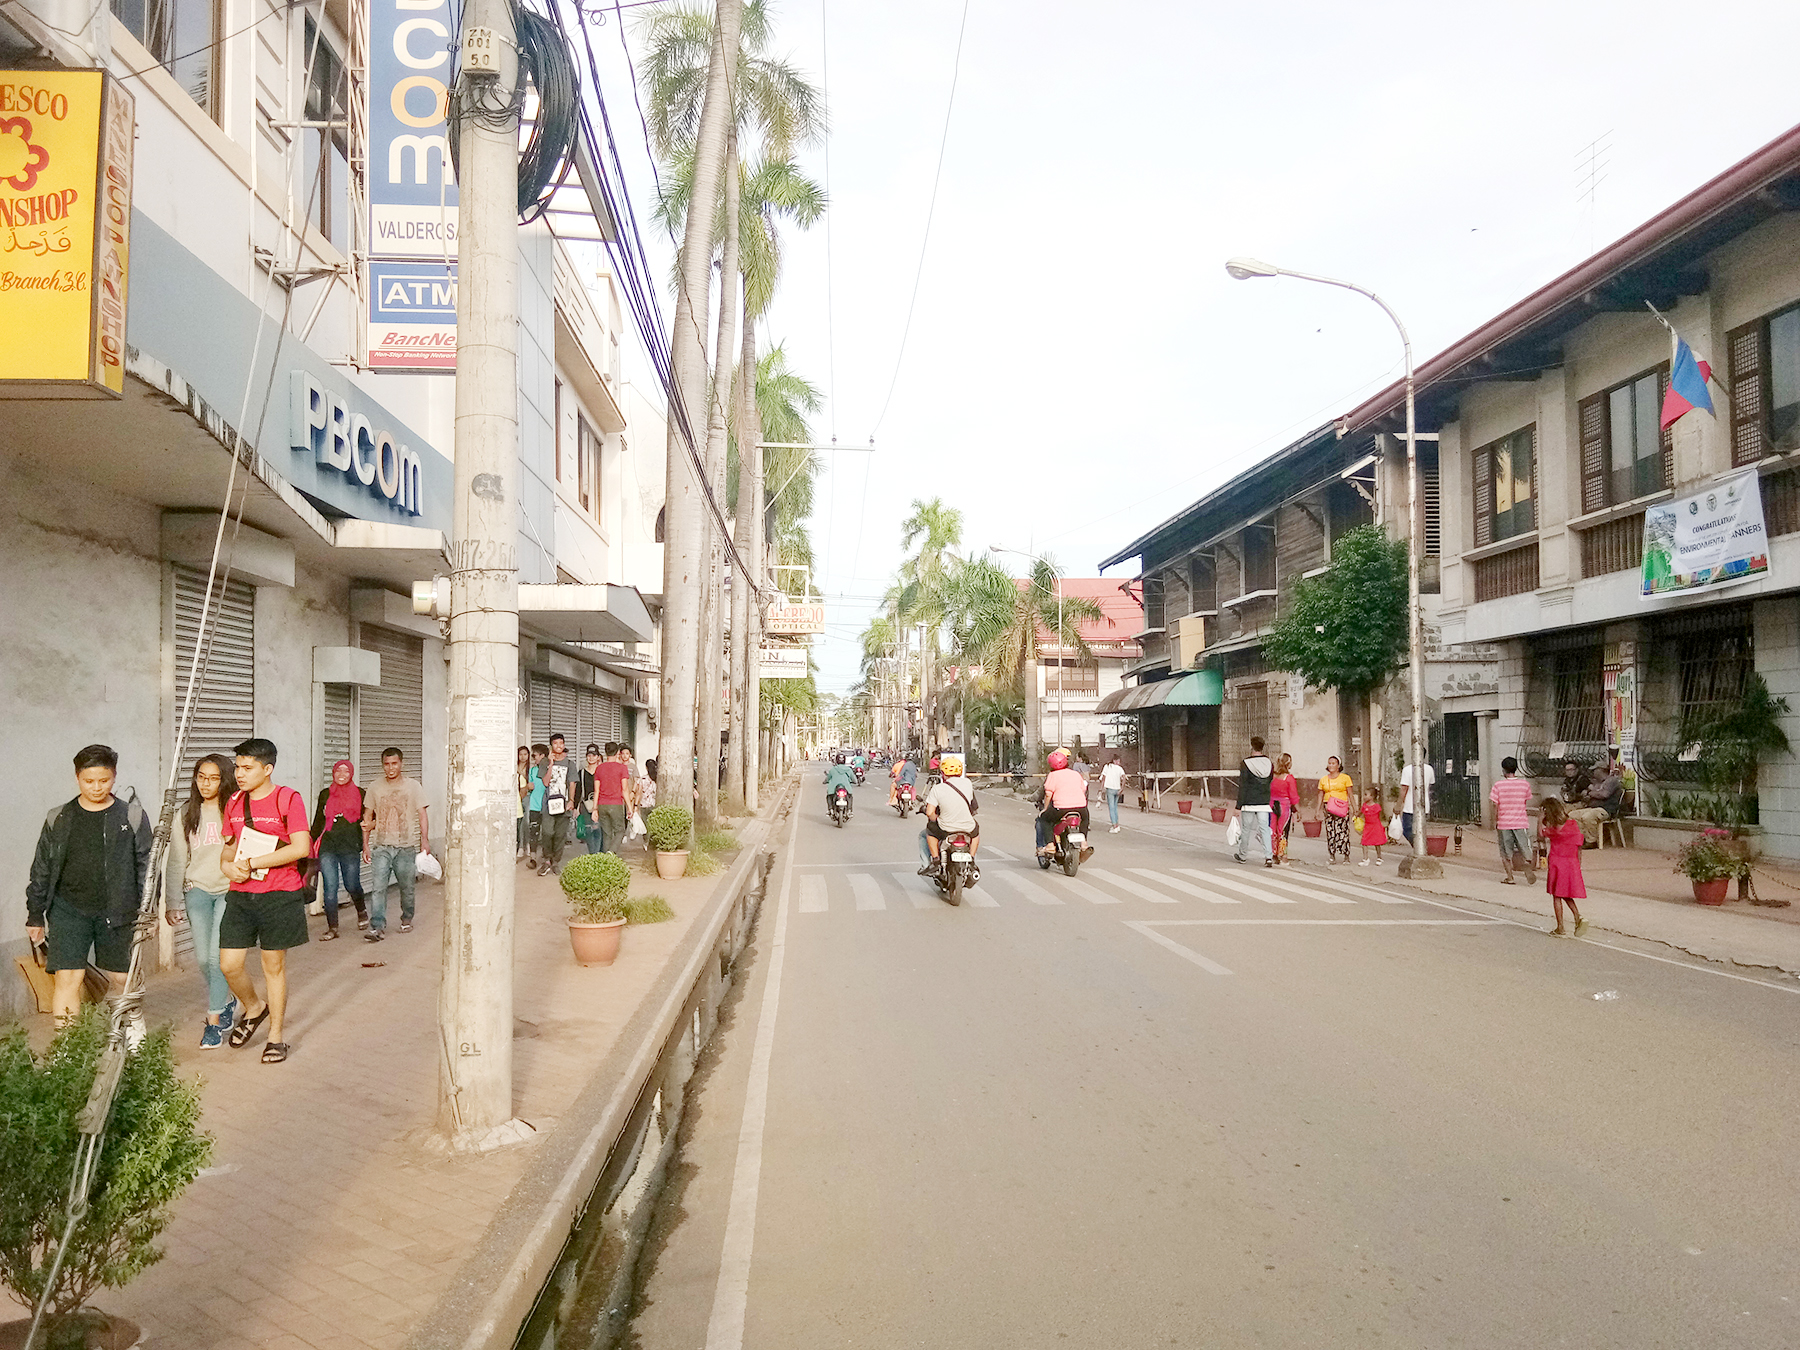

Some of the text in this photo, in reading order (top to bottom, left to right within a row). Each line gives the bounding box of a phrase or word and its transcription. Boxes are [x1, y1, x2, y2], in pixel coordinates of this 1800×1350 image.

[469, 28, 491, 38] ZM
[471, 54, 490, 66] 50
[378, 220, 459, 240] VALDEROS
[384, 282, 458, 306] ATM
[381, 332, 457, 346] BancNe
[460, 1042, 481, 1054] GL
